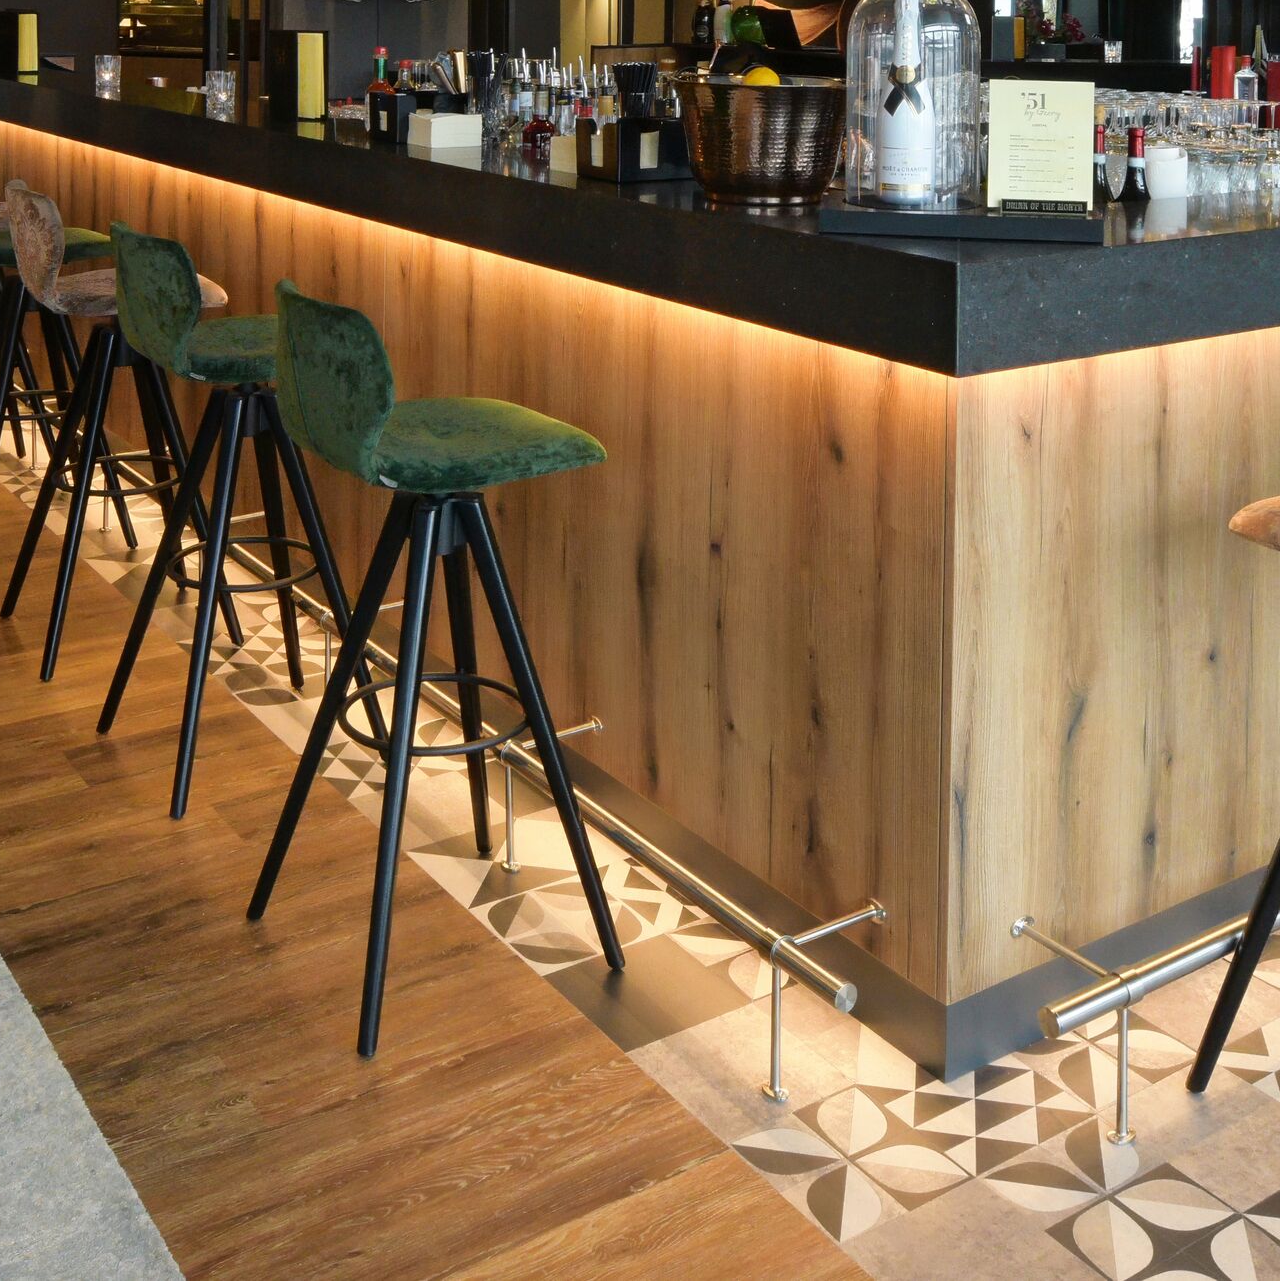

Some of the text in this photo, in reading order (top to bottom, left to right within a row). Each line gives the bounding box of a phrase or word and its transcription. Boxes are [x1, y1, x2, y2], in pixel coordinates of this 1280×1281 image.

[1021, 92, 1046, 109] '51
[1005, 201, 1084, 212] DRINK OF THE MONTH
